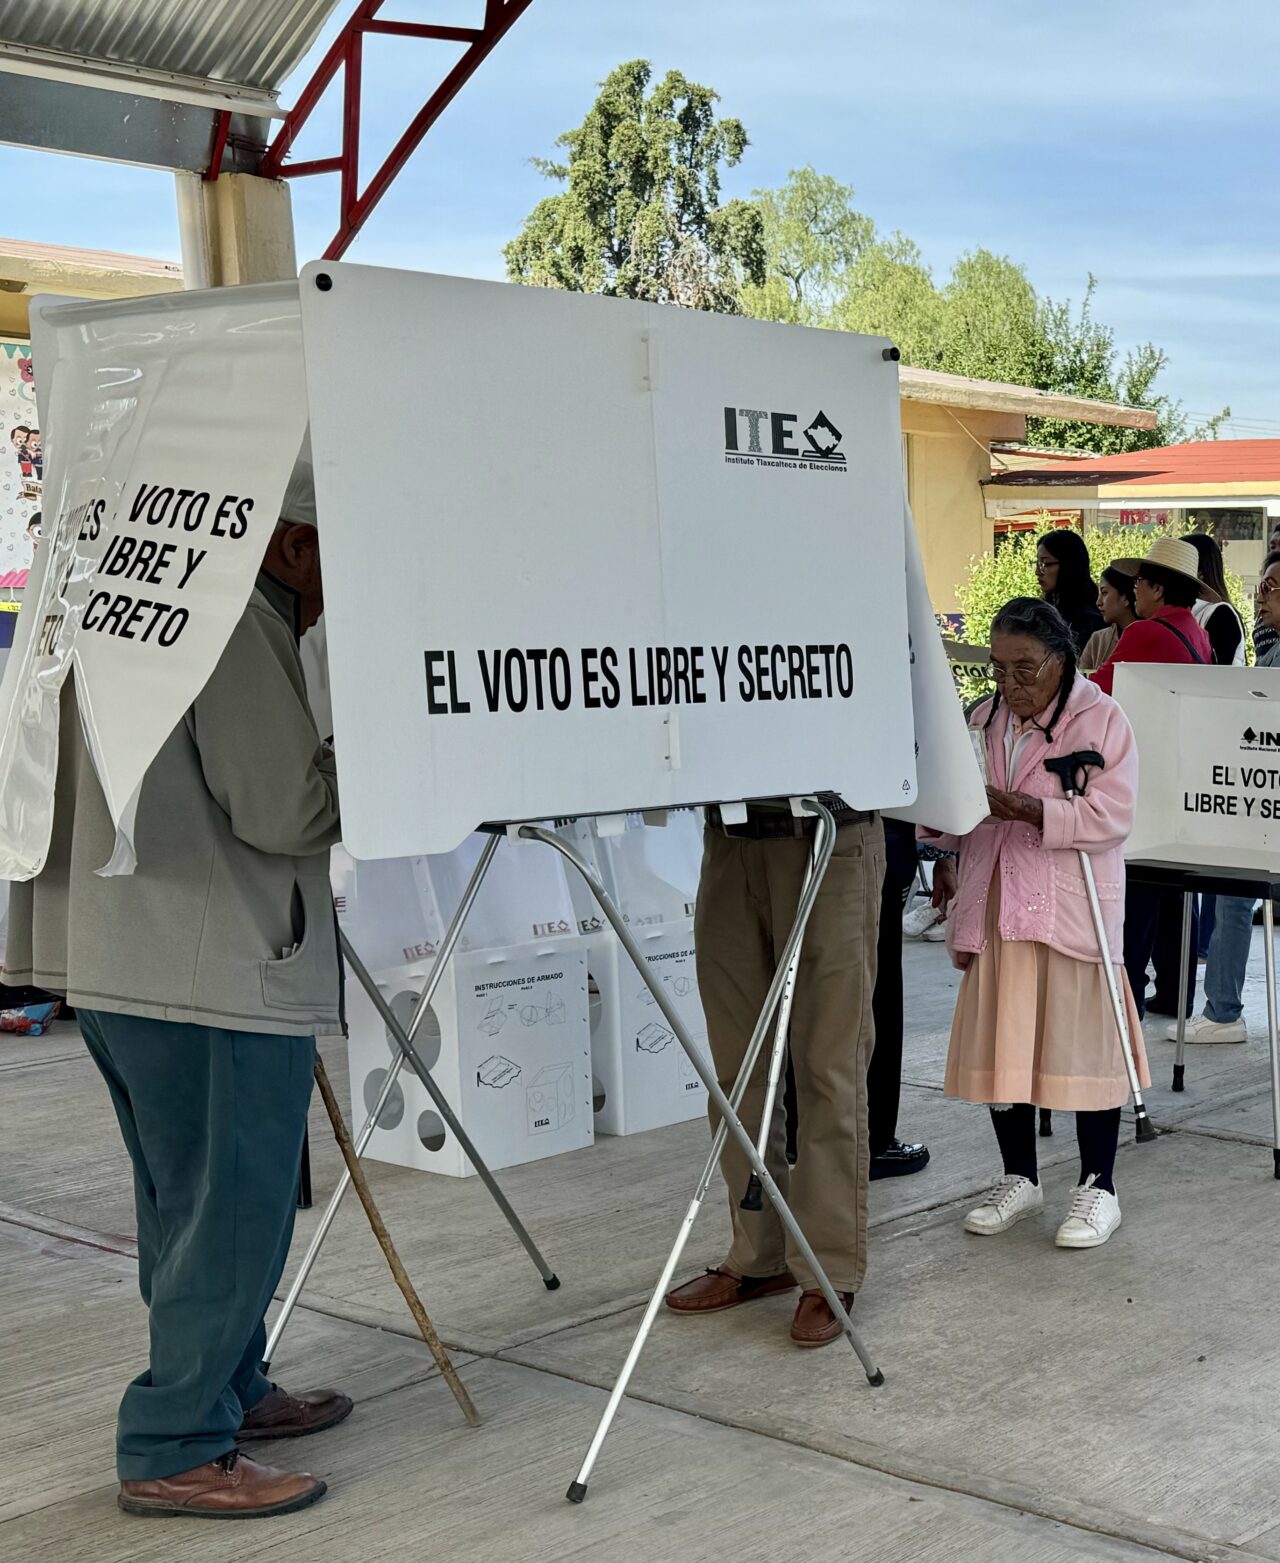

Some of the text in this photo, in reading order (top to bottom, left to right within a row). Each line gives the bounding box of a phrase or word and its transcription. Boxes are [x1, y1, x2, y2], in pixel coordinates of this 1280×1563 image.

[724, 407, 799, 456] ITE
[725, 456, 848, 472] Instituto Tlaxcalteca de Elecciones
[128, 483, 211, 532] VOTO
[210, 495, 254, 540] ES
[97, 535, 208, 590] IBRE Y
[81, 589, 190, 648] CRETO
[424, 650, 471, 714] EL
[477, 647, 571, 713] VOTO
[581, 646, 621, 709] ES
[629, 645, 707, 707] LIBRE
[711, 645, 730, 703] Y
[738, 643, 854, 702] SECRETO
[1212, 765, 1235, 786] EL
[1184, 792, 1238, 815] LIBRE
[1243, 797, 1255, 817] Y
[474, 978, 526, 992] INSTRUCCIONES
[526, 976, 536, 984] DE
[536, 972, 564, 982] ARMADO
